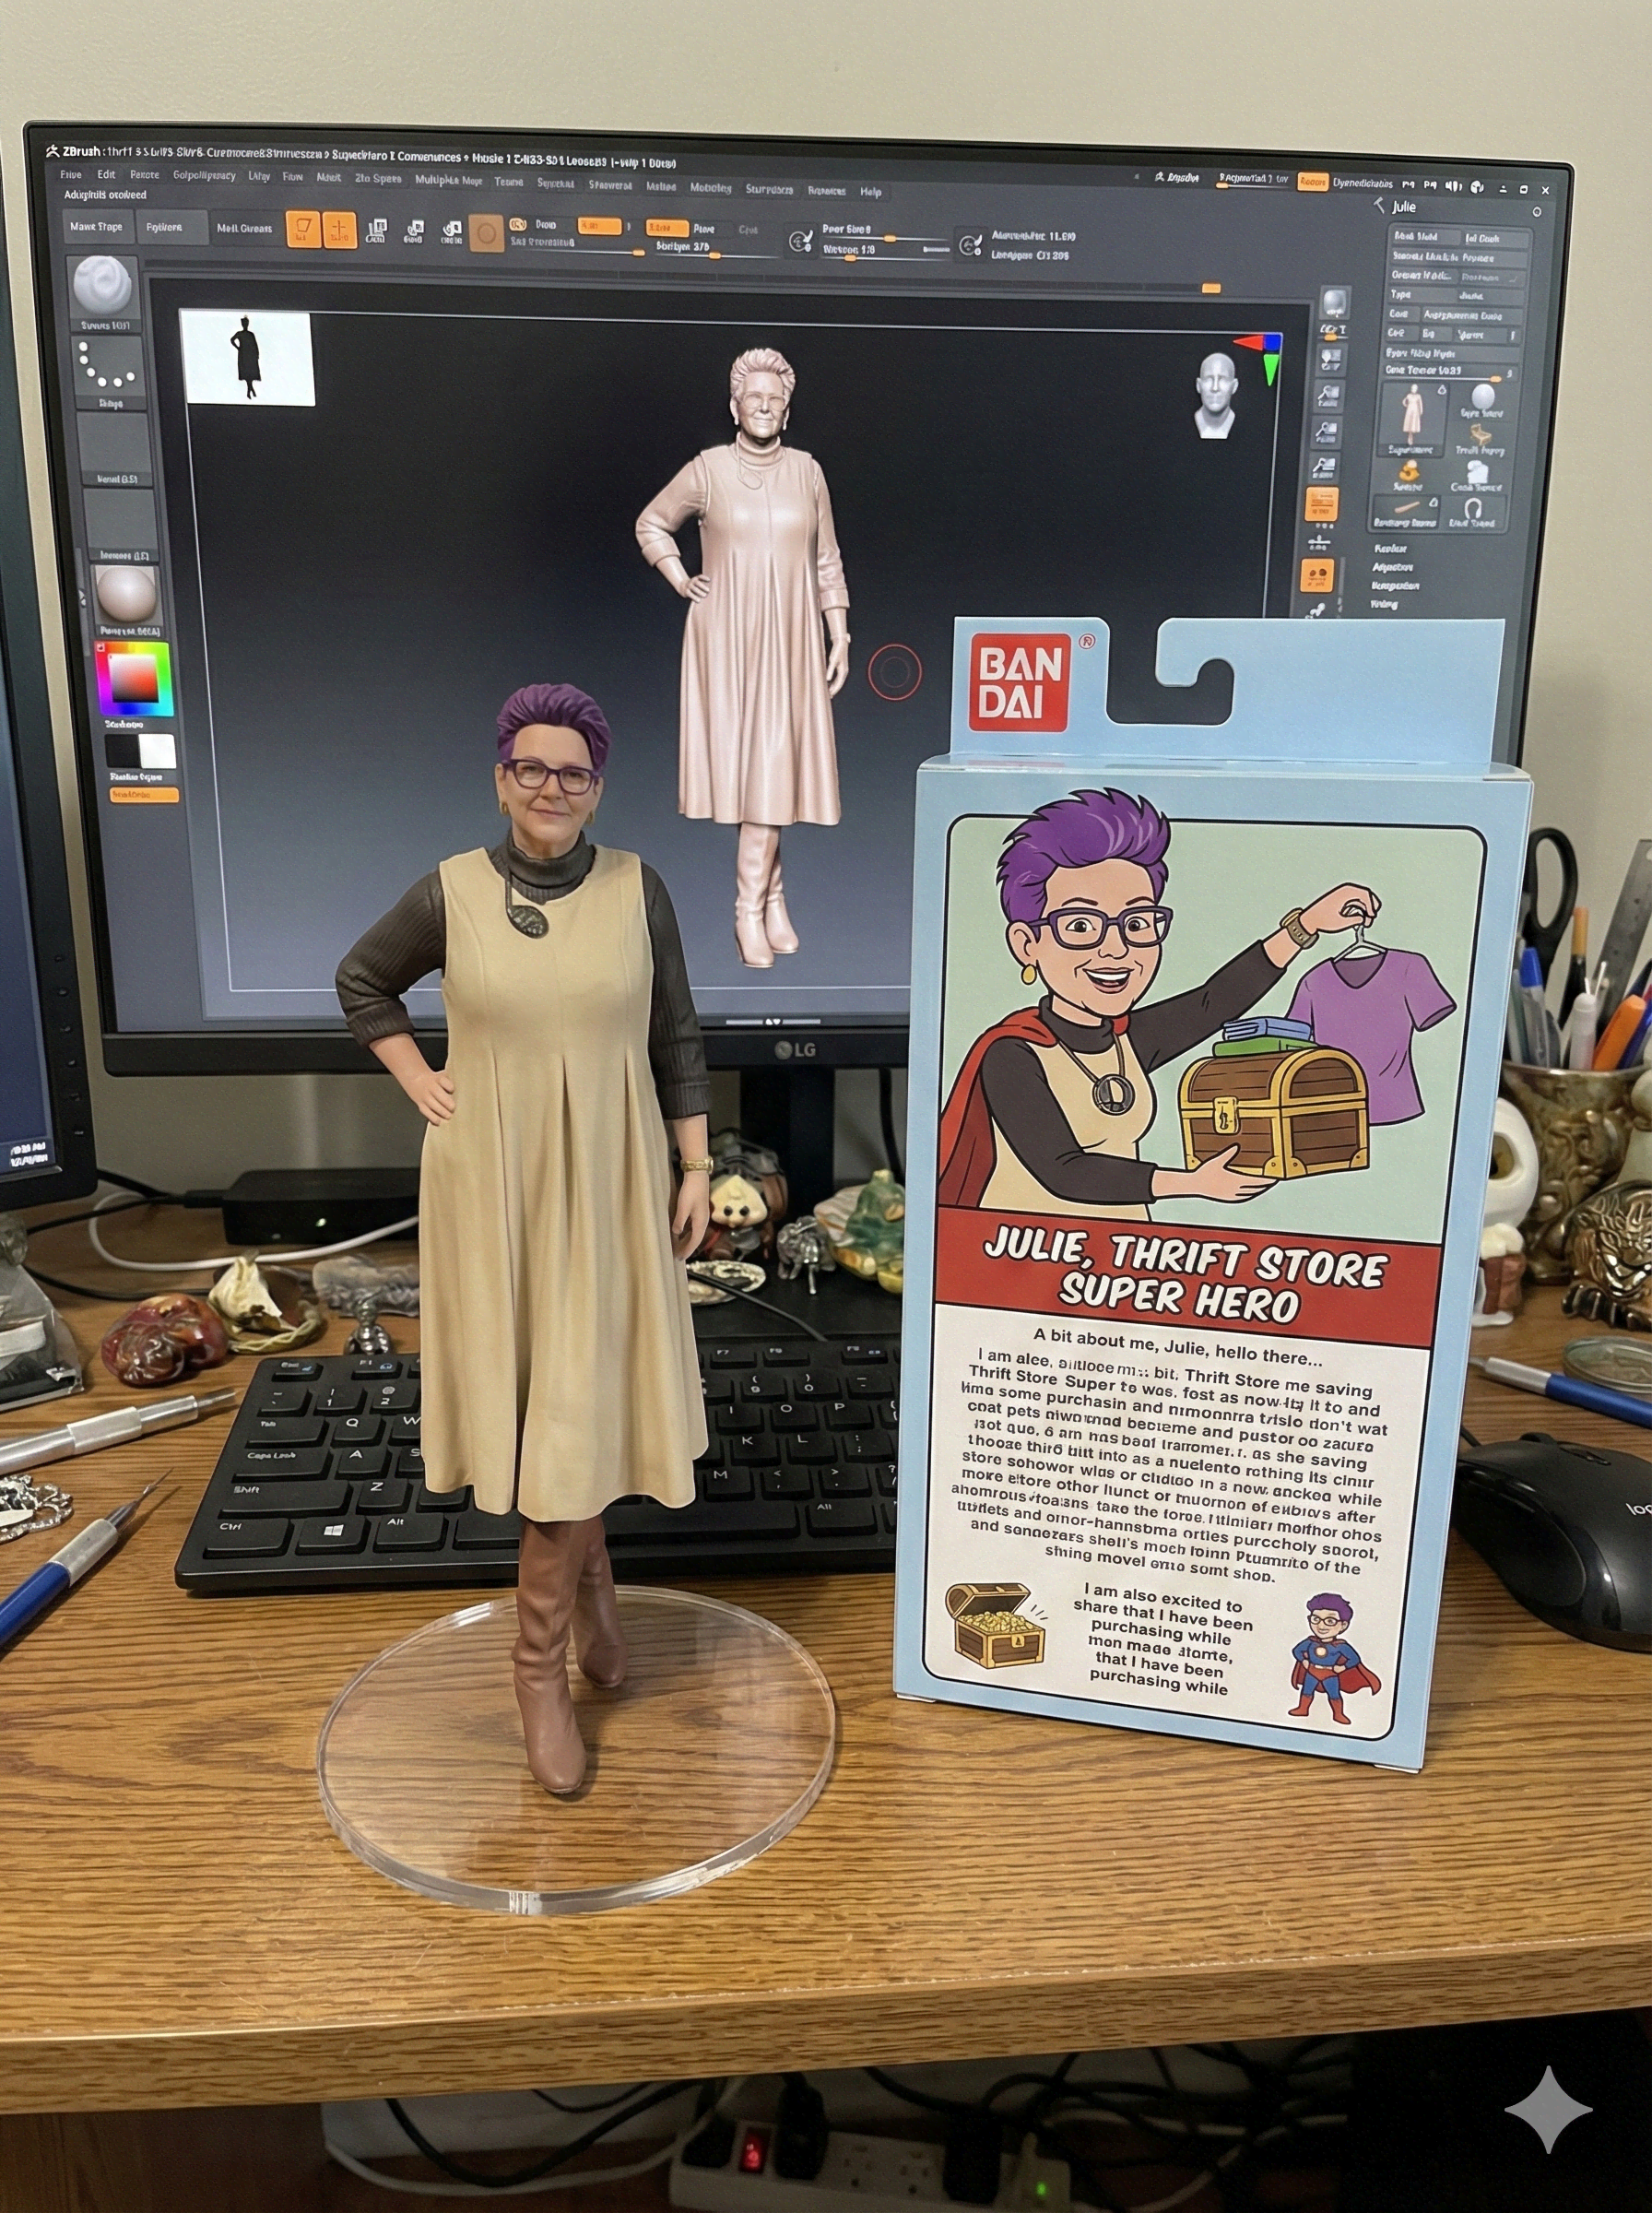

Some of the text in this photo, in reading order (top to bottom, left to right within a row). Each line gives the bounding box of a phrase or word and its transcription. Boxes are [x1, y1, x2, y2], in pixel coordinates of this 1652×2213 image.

[98, 170, 115, 179] Edit
[1392, 201, 1416, 214] Julie
[979, 647, 1062, 681] BAN
[978, 685, 1043, 718] DAI
[796, 1043, 815, 1057] LG
[985, 1225, 1389, 1288] JULIE, THRIFT STORE
[1058, 1272, 1300, 1324] SUPER HERO
[1033, 1328, 1322, 1367] A bit about me, Julie, hello there...
[969, 1365, 1010, 1380] Thrift
[1017, 1370, 1057, 1385] Store
[1066, 1375, 1115, 1391] Super
[1220, 1393, 1238, 1403] as
[1325, 1402, 1342, 1414] to
[1349, 1405, 1380, 1417] and
[988, 1352, 1011, 1362] am
[1185, 1369, 1229, 1385] Thrift
[1235, 1374, 1280, 1389] Store
[1285, 1381, 1310, 1392] me
[1316, 1383, 1372, 1400] saving
[347, 1418, 358, 1426] Q
[404, 1416, 420, 1425] W
[999, 1389, 1041, 1401] some
[1046, 1393, 1126, 1410] purchasin
[1133, 1402, 1162, 1414] and
[1358, 1425, 1387, 1436] wat
[1008, 1406, 1040, 1418] pets
[1202, 1427, 1233, 1438] and
[1099, 1450, 1127, 1462] into
[1132, 1455, 1150, 1465] as
[1156, 1458, 1163, 1466] a
[1277, 1450, 1304, 1463] she
[1311, 1456, 1367, 1473] saving
[371, 1483, 383, 1491] Z
[962, 1451, 1001, 1465] store
[1120, 1472, 1137, 1480] or
[1339, 1493, 1382, 1507] while
[1014, 1509, 1041, 1521] and
[1134, 1505, 1158, 1518] the
[1154, 1492, 1171, 1501] or
[1338, 1510, 1375, 1523] after
[972, 1521, 998, 1532] and
[1315, 1561, 1330, 1571] of
[1335, 1562, 1361, 1575] the
[1084, 1582, 1242, 1613] I am also excited to
[1074, 1599, 1253, 1631] share that I have been
[1092, 1620, 1231, 1645] purchasing while
[1096, 1651, 1223, 1678] that I have been
[1091, 1670, 1228, 1696] purchasing while
